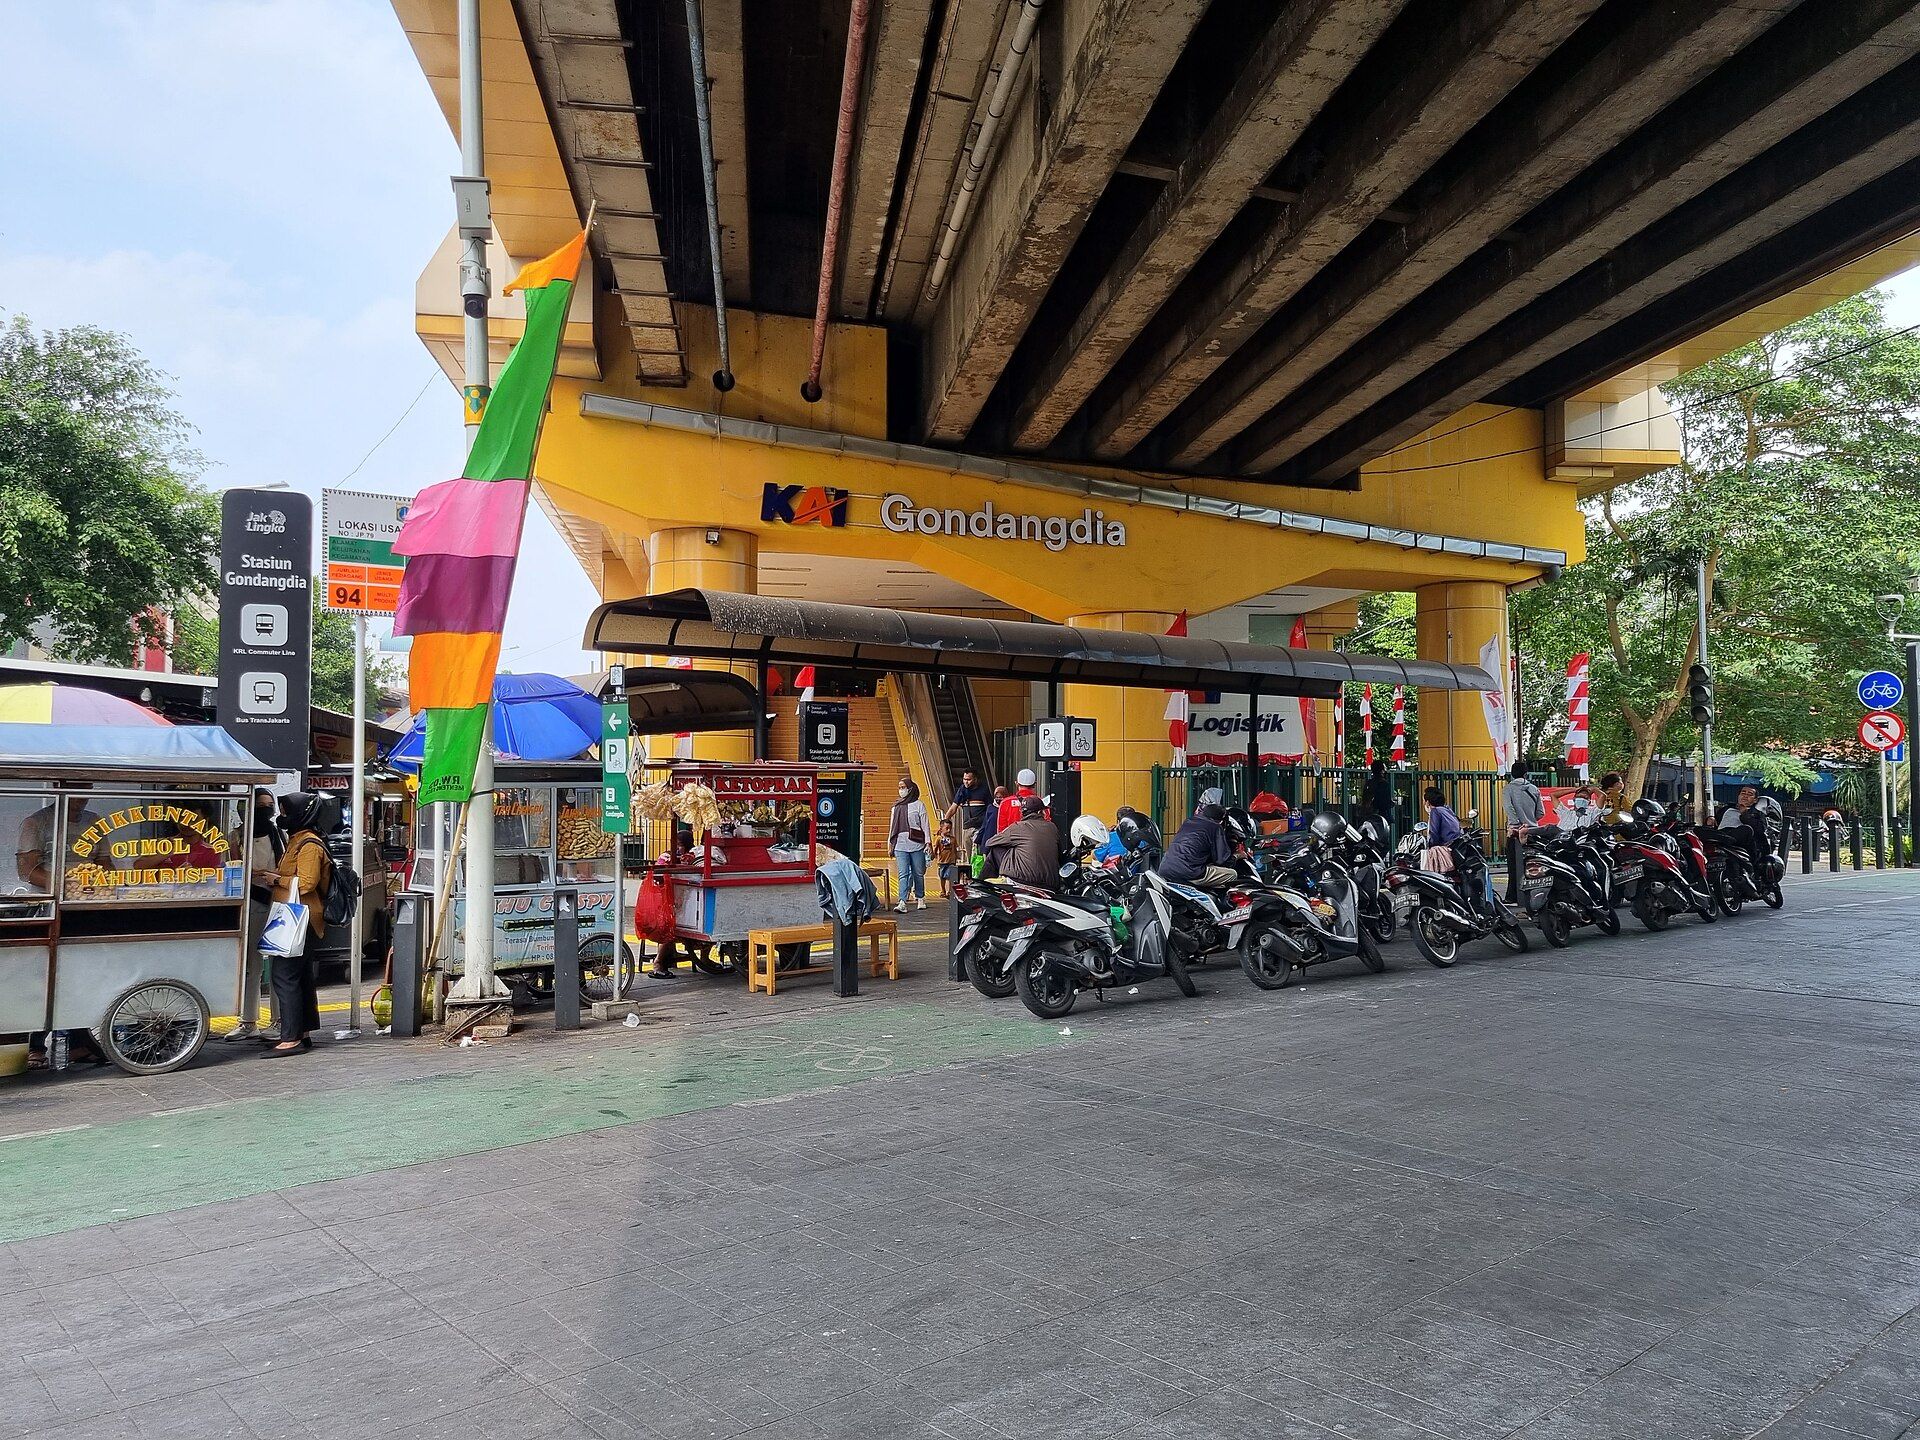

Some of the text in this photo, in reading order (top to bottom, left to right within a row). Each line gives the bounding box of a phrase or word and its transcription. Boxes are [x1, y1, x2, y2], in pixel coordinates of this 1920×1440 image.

[760, 482, 848, 527] KAI
[246, 511, 267, 522] Jak
[880, 494, 1127, 551] Gondangdia
[246, 522, 286, 534] Lingko
[338, 520, 401, 534] LOKASI USA
[241, 554, 292, 570] Stasiun
[225, 571, 307, 591] Gondangdia
[335, 586, 362, 606] 94
[248, 648, 281, 656] Commuter
[1188, 713, 1286, 737] Logistik
[1043, 728, 1050, 740] P
[1074, 728, 1081, 740] P
[609, 744, 617, 762] P
[715, 777, 811, 793] KETOPRAK
[824, 803, 829, 811] B
[111, 837, 191, 859] CIMOL
[78, 867, 225, 887] TAHUKRISPI
[493, 893, 615, 915] AHU CSPY
[536, 943, 555, 951] Terim
